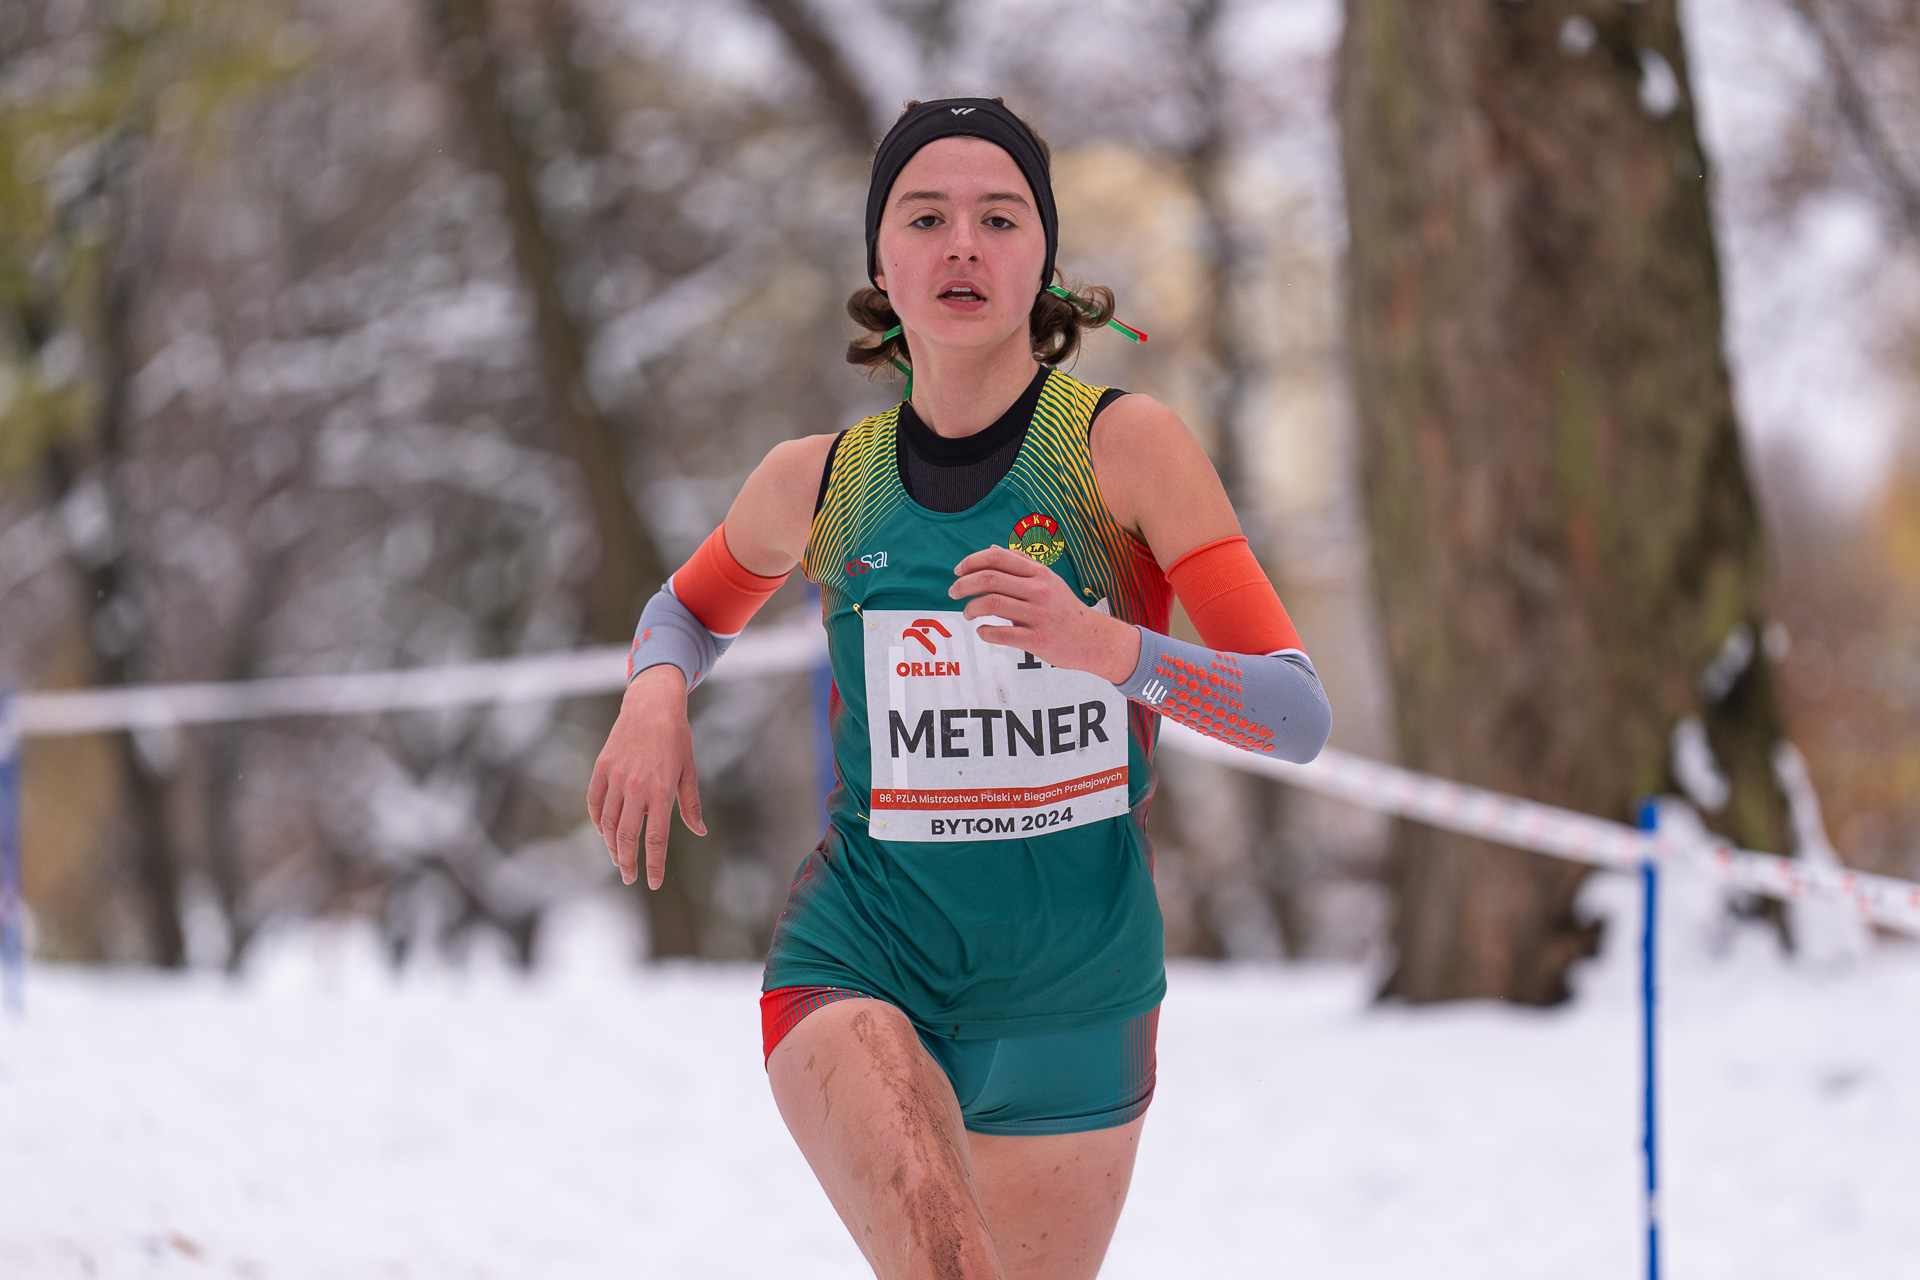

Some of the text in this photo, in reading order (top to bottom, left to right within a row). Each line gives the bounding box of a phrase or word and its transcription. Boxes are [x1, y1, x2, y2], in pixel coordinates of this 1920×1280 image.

[1021, 514, 1052, 529] LKS
[896, 661, 961, 678] ORLEN
[888, 700, 1110, 759] METNER
[879, 793, 894, 803] 96.
[896, 794, 918, 804] PZLA
[919, 794, 979, 804] Mistrzostwa
[981, 793, 1011, 803] Polski
[1023, 787, 1063, 802] Biegach
[1064, 771, 1123, 794] Przełajowych
[931, 806, 1074, 836] BYTOM 2024
